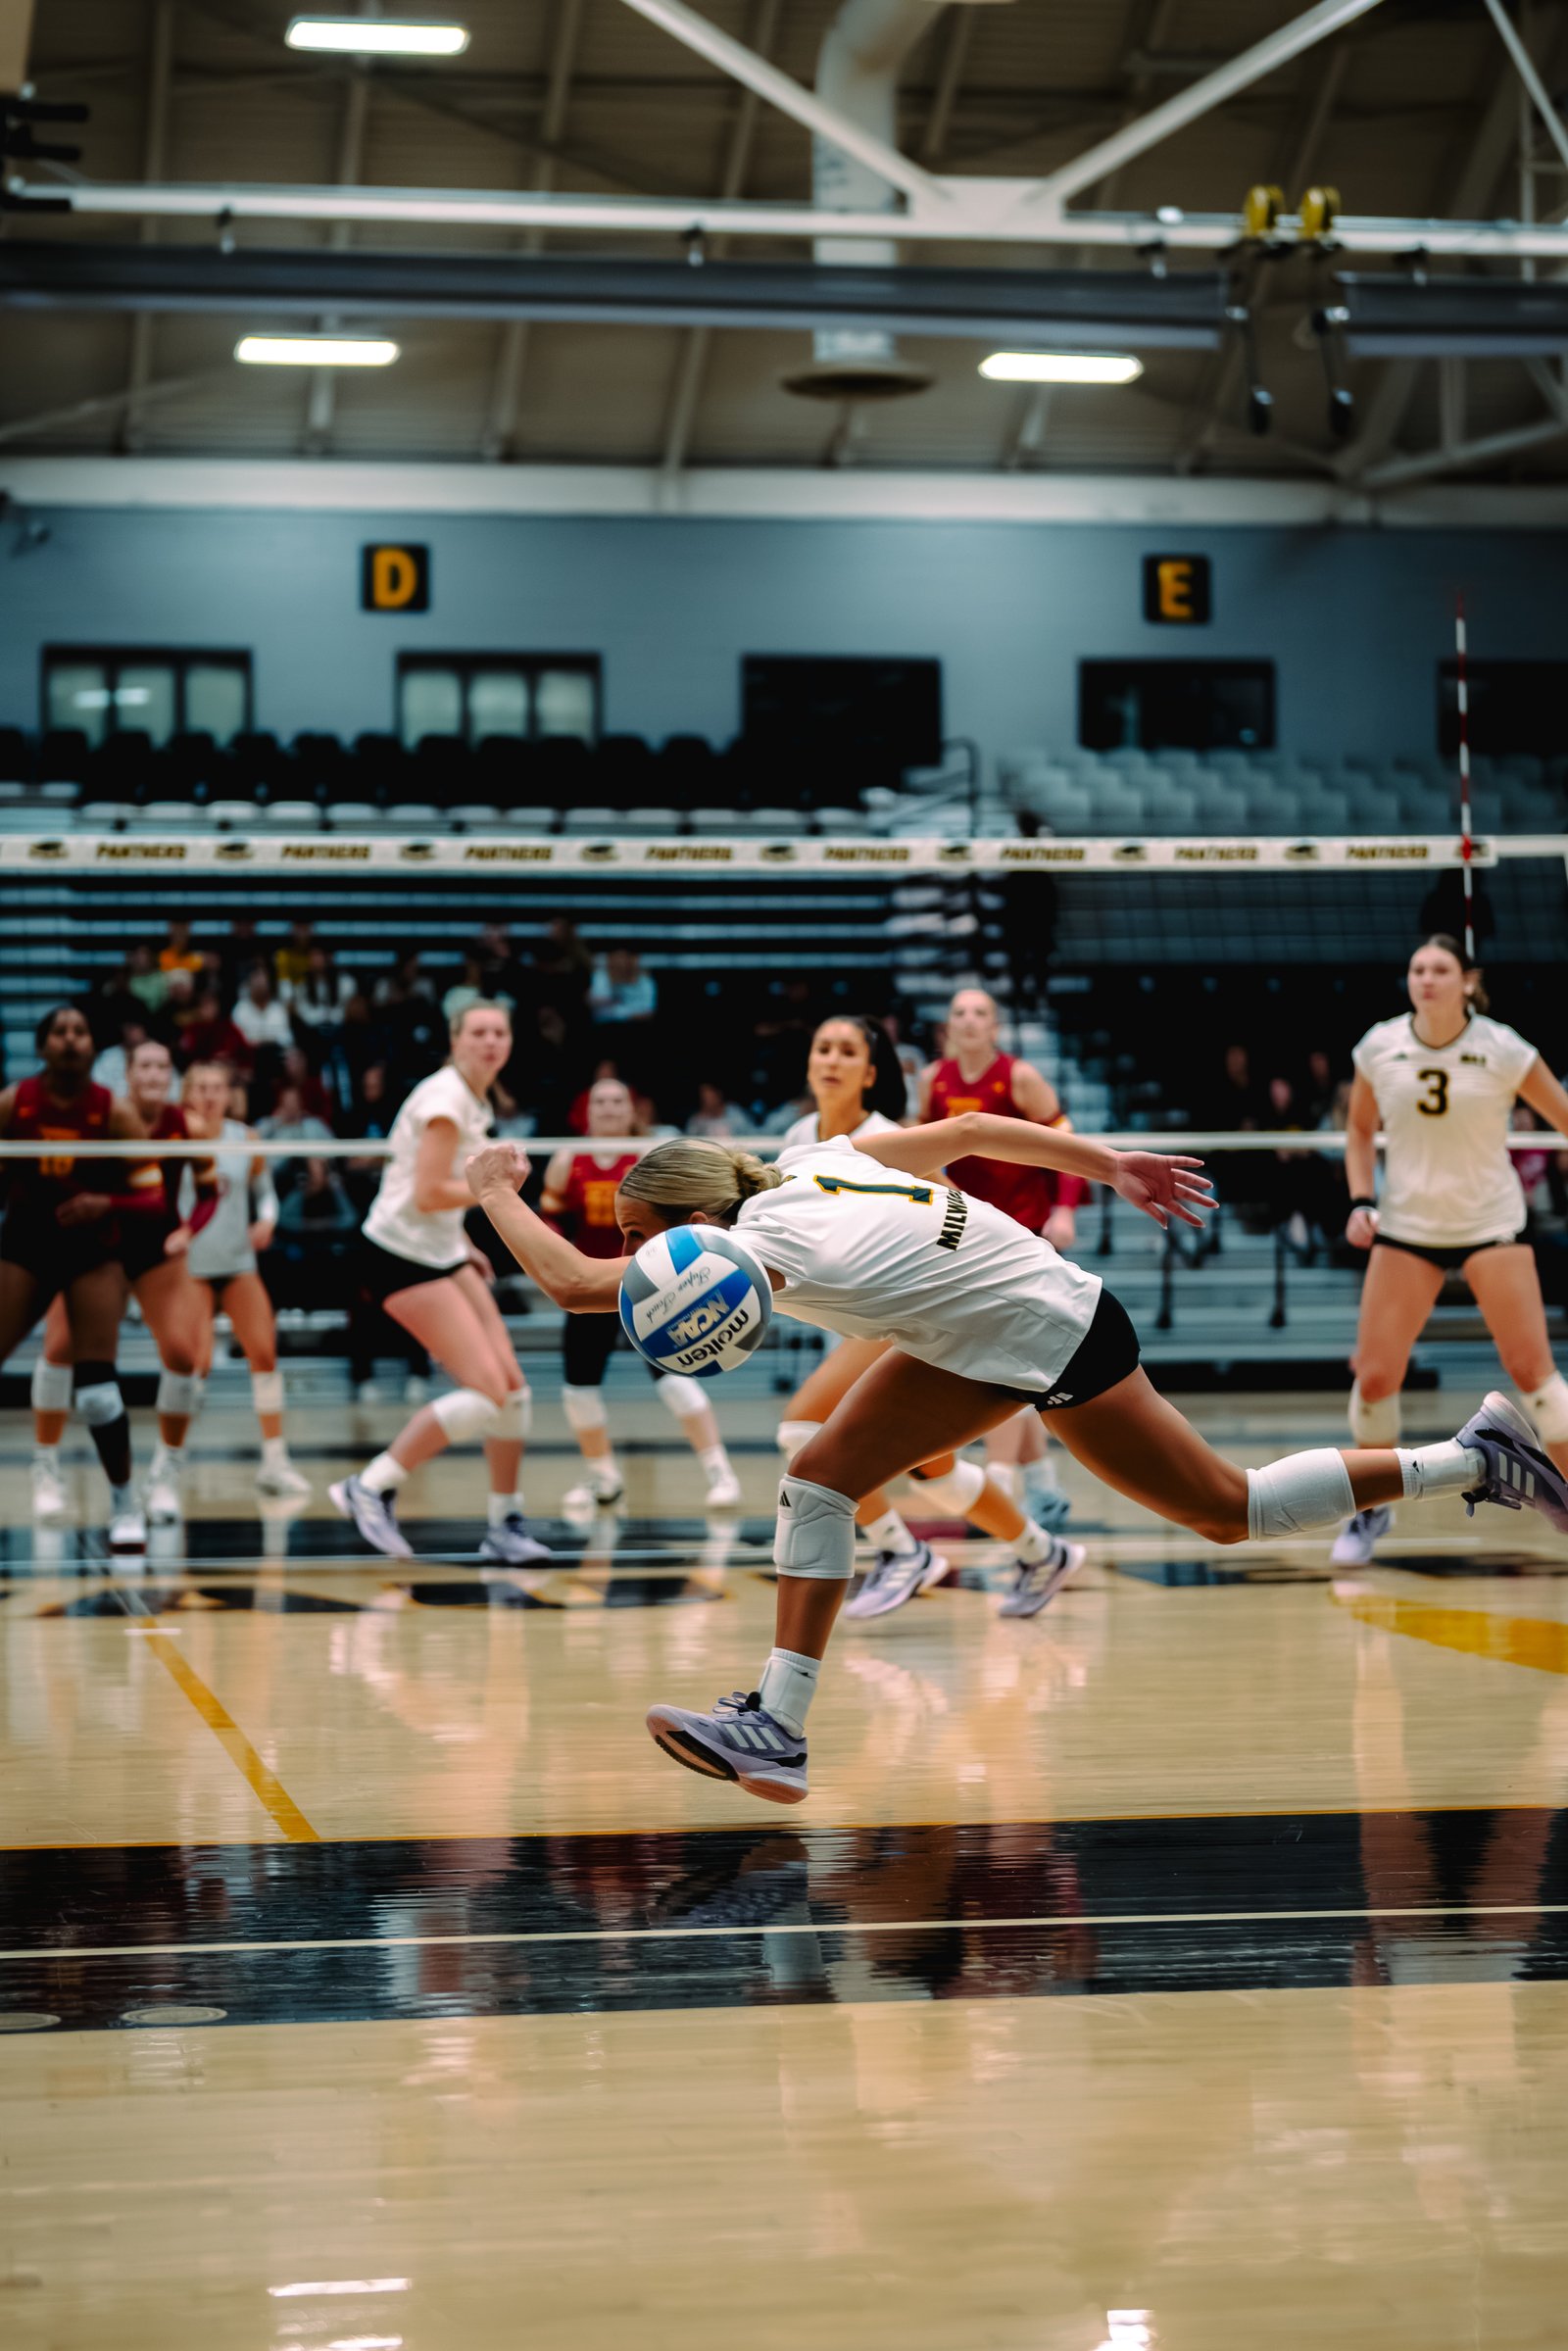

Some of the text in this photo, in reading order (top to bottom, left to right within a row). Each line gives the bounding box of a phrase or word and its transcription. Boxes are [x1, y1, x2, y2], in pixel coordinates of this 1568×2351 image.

[373, 548, 417, 608] D
[1158, 561, 1193, 616] E
[1417, 1068, 1448, 1116] 3
[813, 1174, 933, 1206] 1
[677, 1266, 711, 1291] Super
[646, 1291, 676, 1323] Touch
[666, 1290, 730, 1347] NCAA
[676, 1308, 750, 1367] molten
